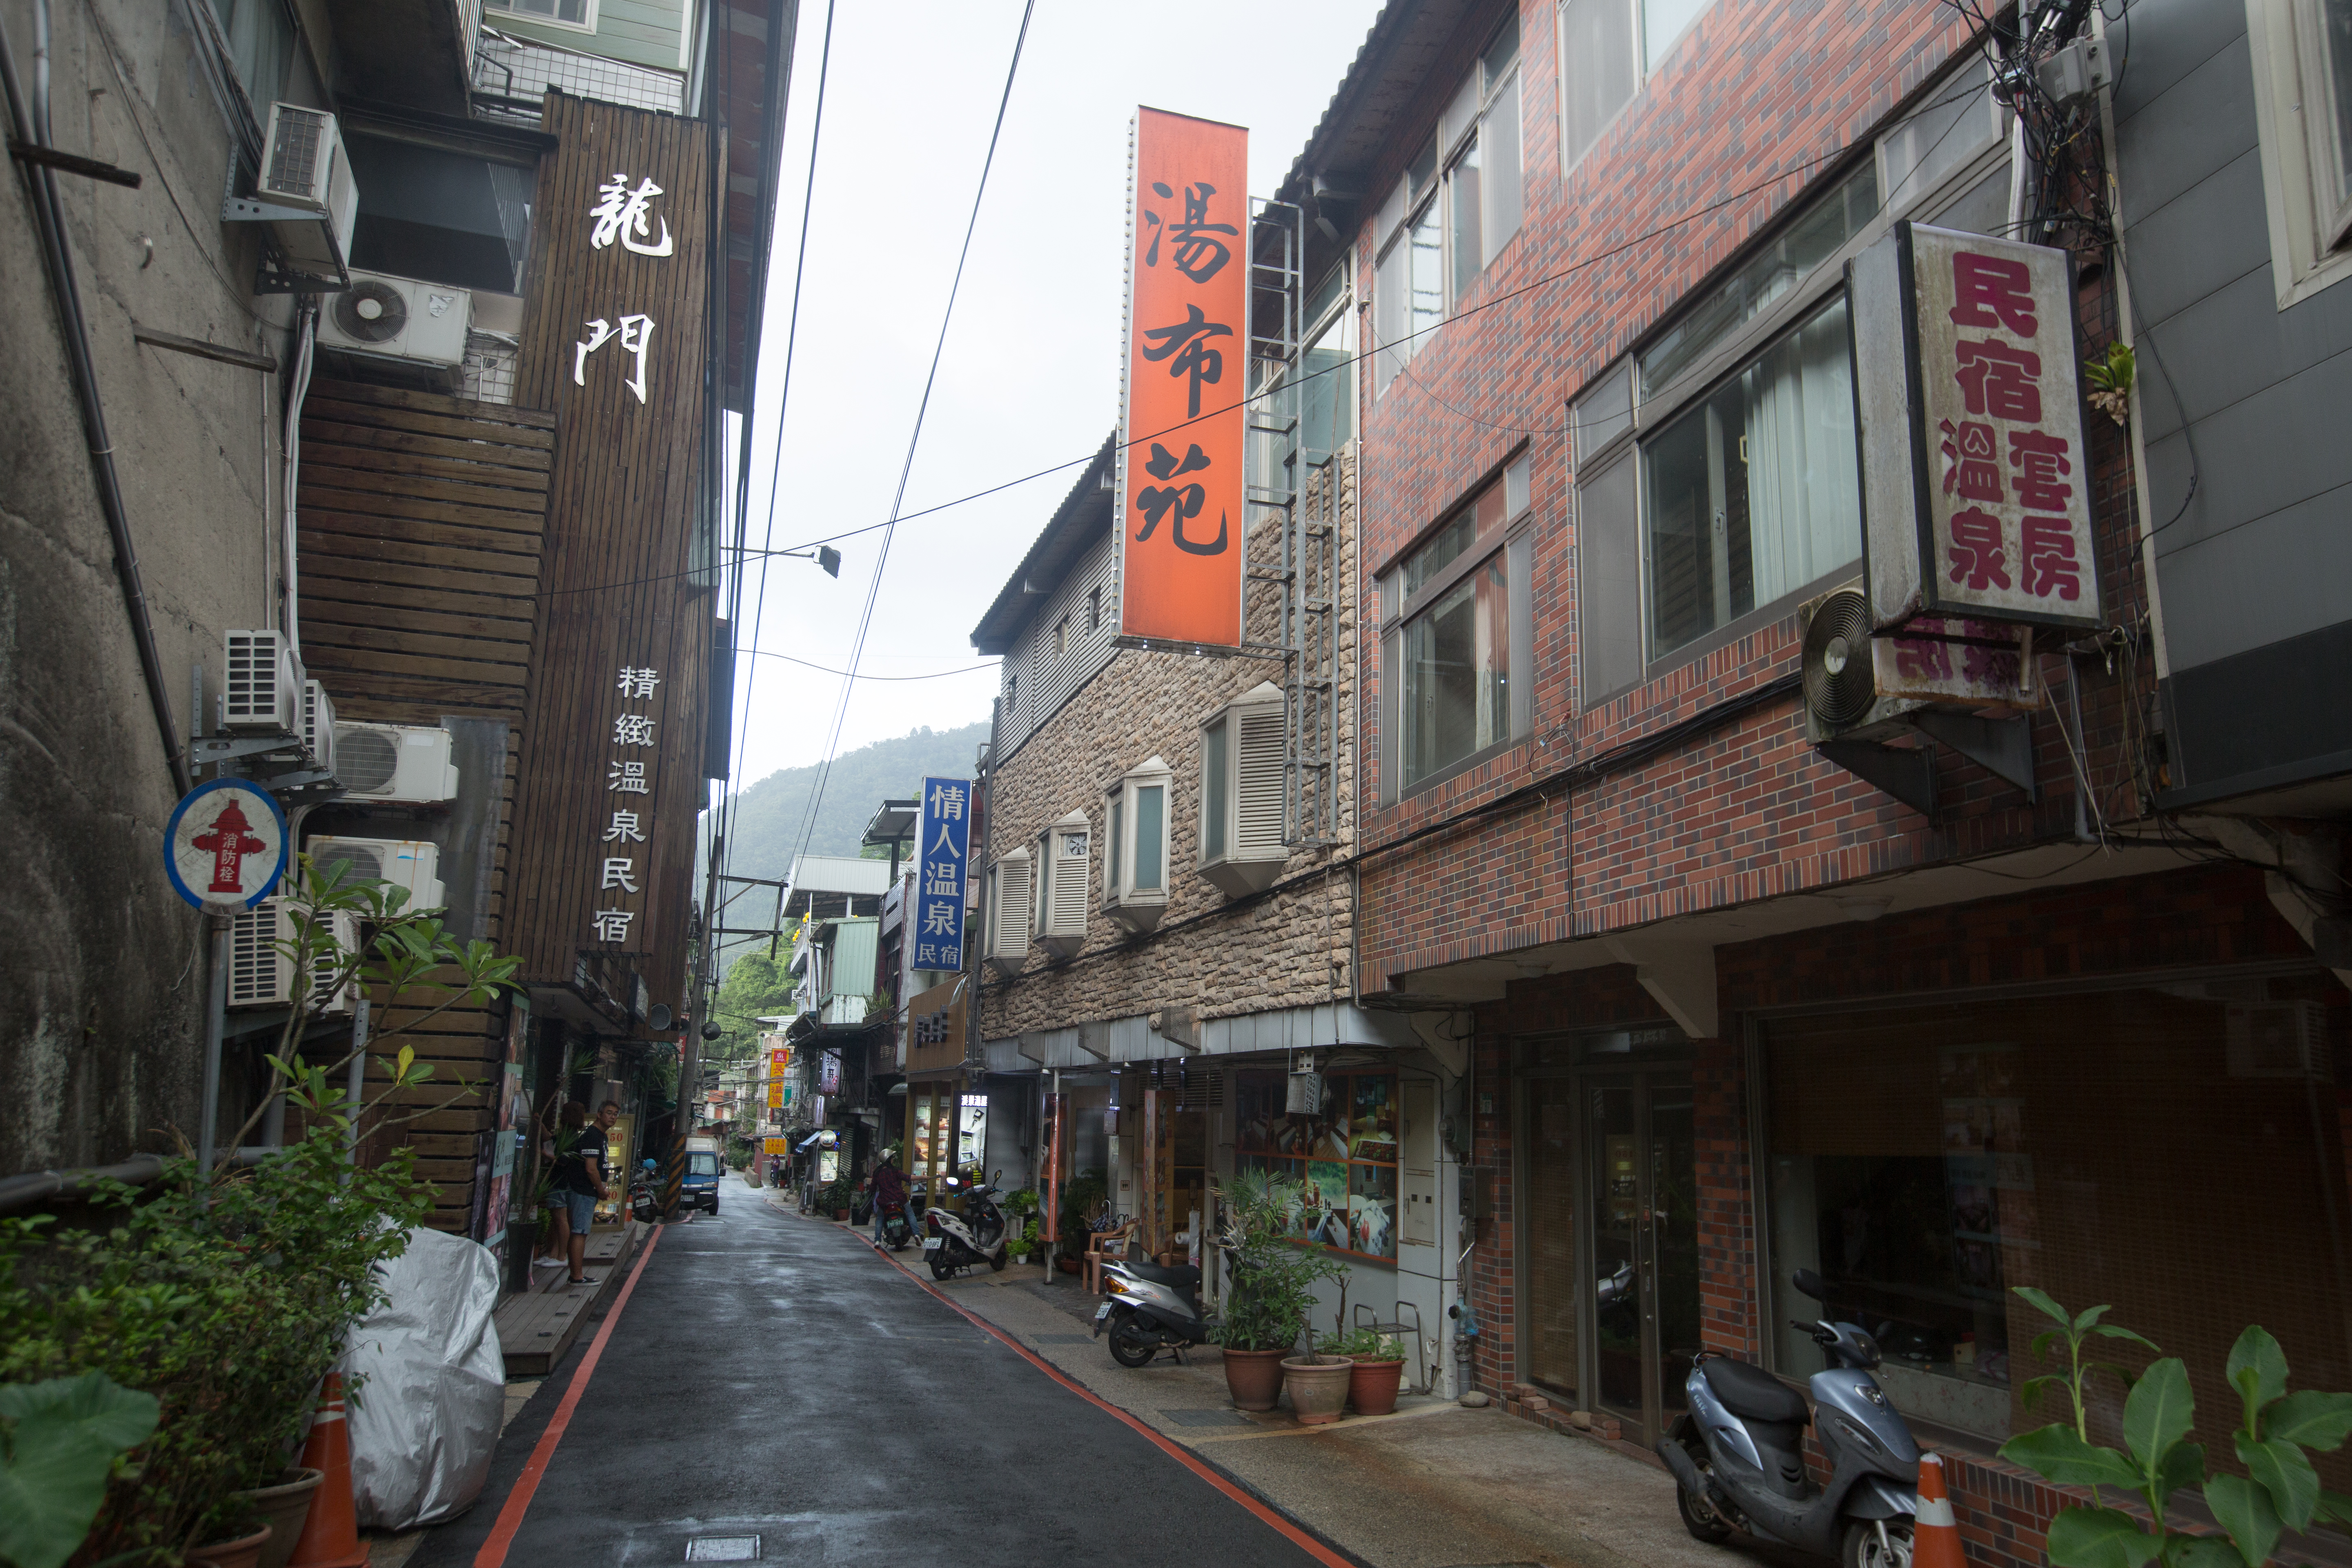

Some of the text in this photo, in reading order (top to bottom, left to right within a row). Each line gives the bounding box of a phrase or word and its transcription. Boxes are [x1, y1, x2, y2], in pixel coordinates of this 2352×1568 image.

[575, 174, 673, 404] 龍門
[1135, 182, 1239, 557] 湯布苑
[1949, 252, 2041, 423] 民宿
[2009, 430, 2080, 601] 套房
[220, 833, 238, 882] 消防栓
[592, 666, 661, 942] 精緻溫泉民宿
[917, 943, 959, 964] 民宿
[606, 1133, 623, 1142] 50
